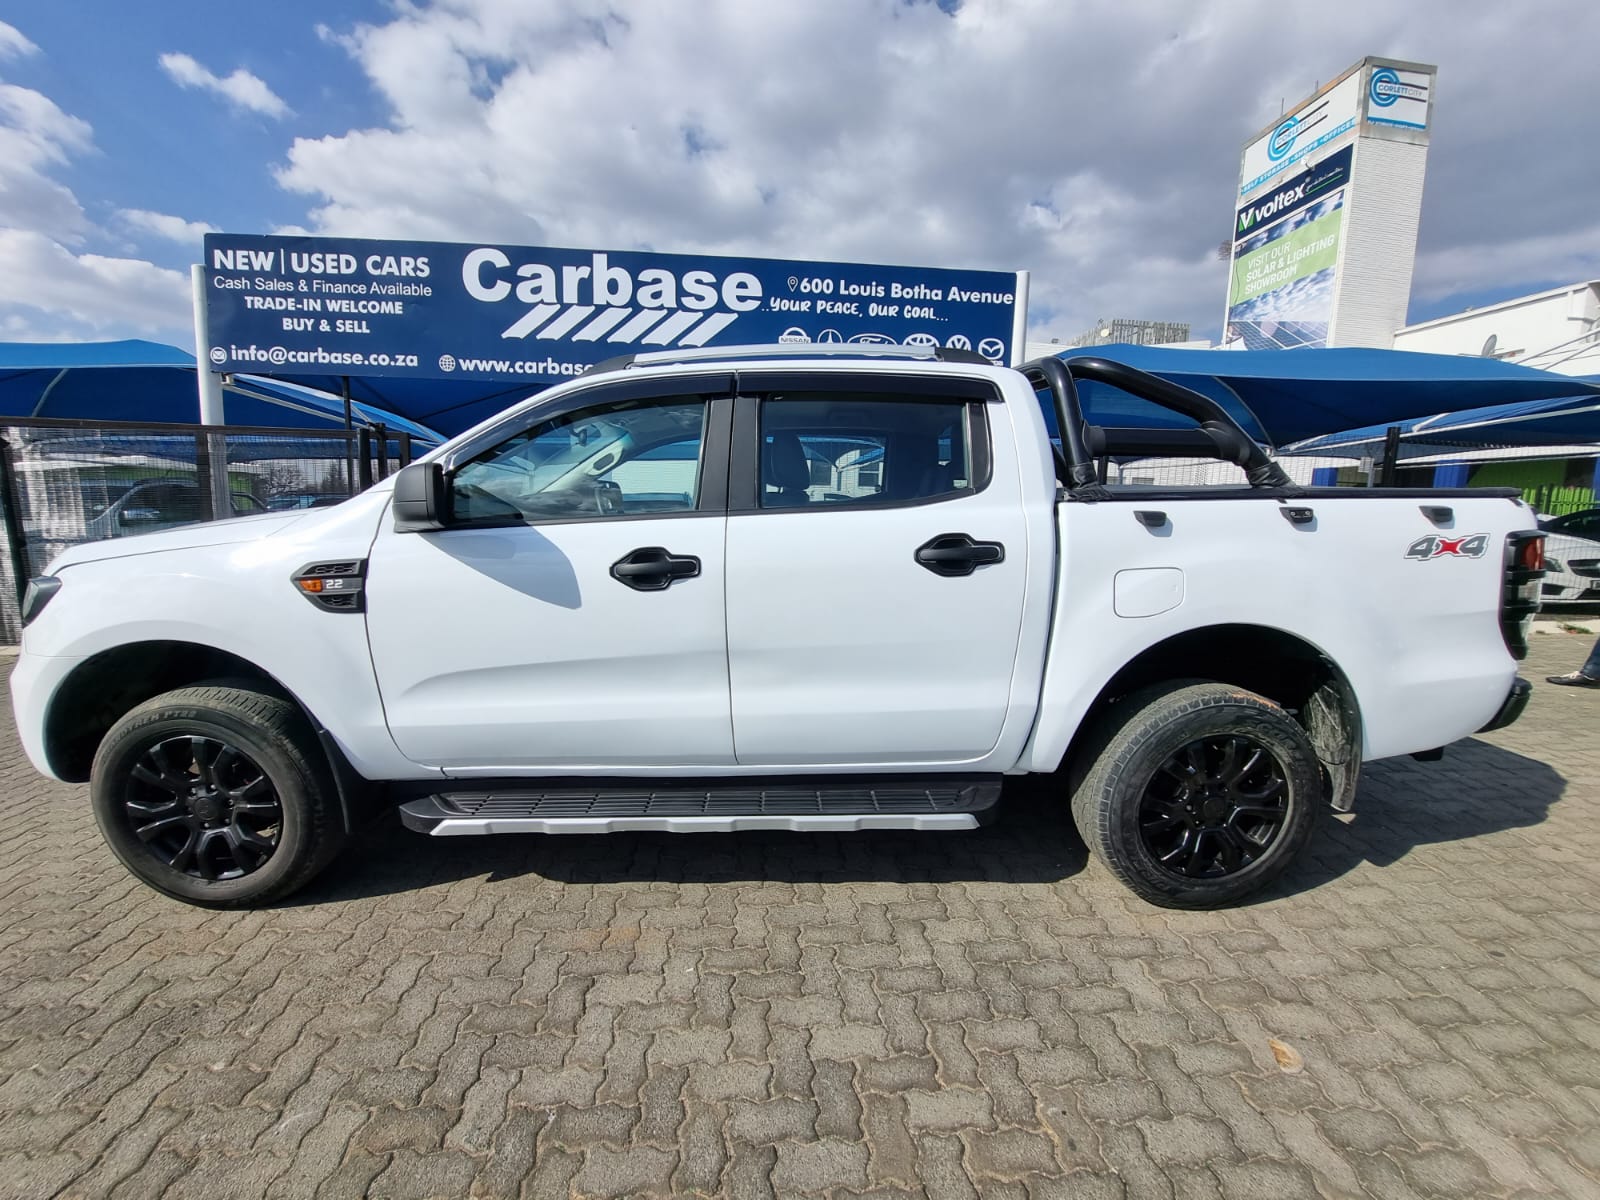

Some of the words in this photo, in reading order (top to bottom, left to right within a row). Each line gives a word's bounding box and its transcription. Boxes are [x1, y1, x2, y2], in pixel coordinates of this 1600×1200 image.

[1255, 183, 1306, 222] voltex
[213, 249, 275, 271] NEW
[290, 252, 357, 275] USED
[366, 255, 431, 278] CARS
[1246, 260, 1277, 283] SOLAR
[1287, 234, 1336, 266] LIGHTING
[1248, 251, 1272, 269] VISIT
[1271, 241, 1292, 260] OUR
[213, 275, 251, 290] Cash
[254, 277, 295, 292] Sales
[297, 278, 309, 293] &
[312, 279, 367, 294] Finance
[369, 281, 433, 297] Available
[462, 248, 763, 312] Carbase
[800, 277, 834, 294] 600
[839, 279, 886, 297] Louis
[890, 282, 943, 301] Botha
[947, 286, 1014, 305] Avenue
[1244, 264, 1298, 296] SHOWROOM
[244, 295, 322, 312] TRADE-IN
[325, 299, 404, 315] WELCOME
[816, 300, 863, 318] PEACE,
[868, 302, 900, 317] OUR
[903, 305, 949, 321] GOAL...
[282, 317, 315, 332] BUY
[319, 319, 332, 332] &
[335, 319, 371, 334] SELL
[230, 344, 419, 367] info@carbase.co.za
